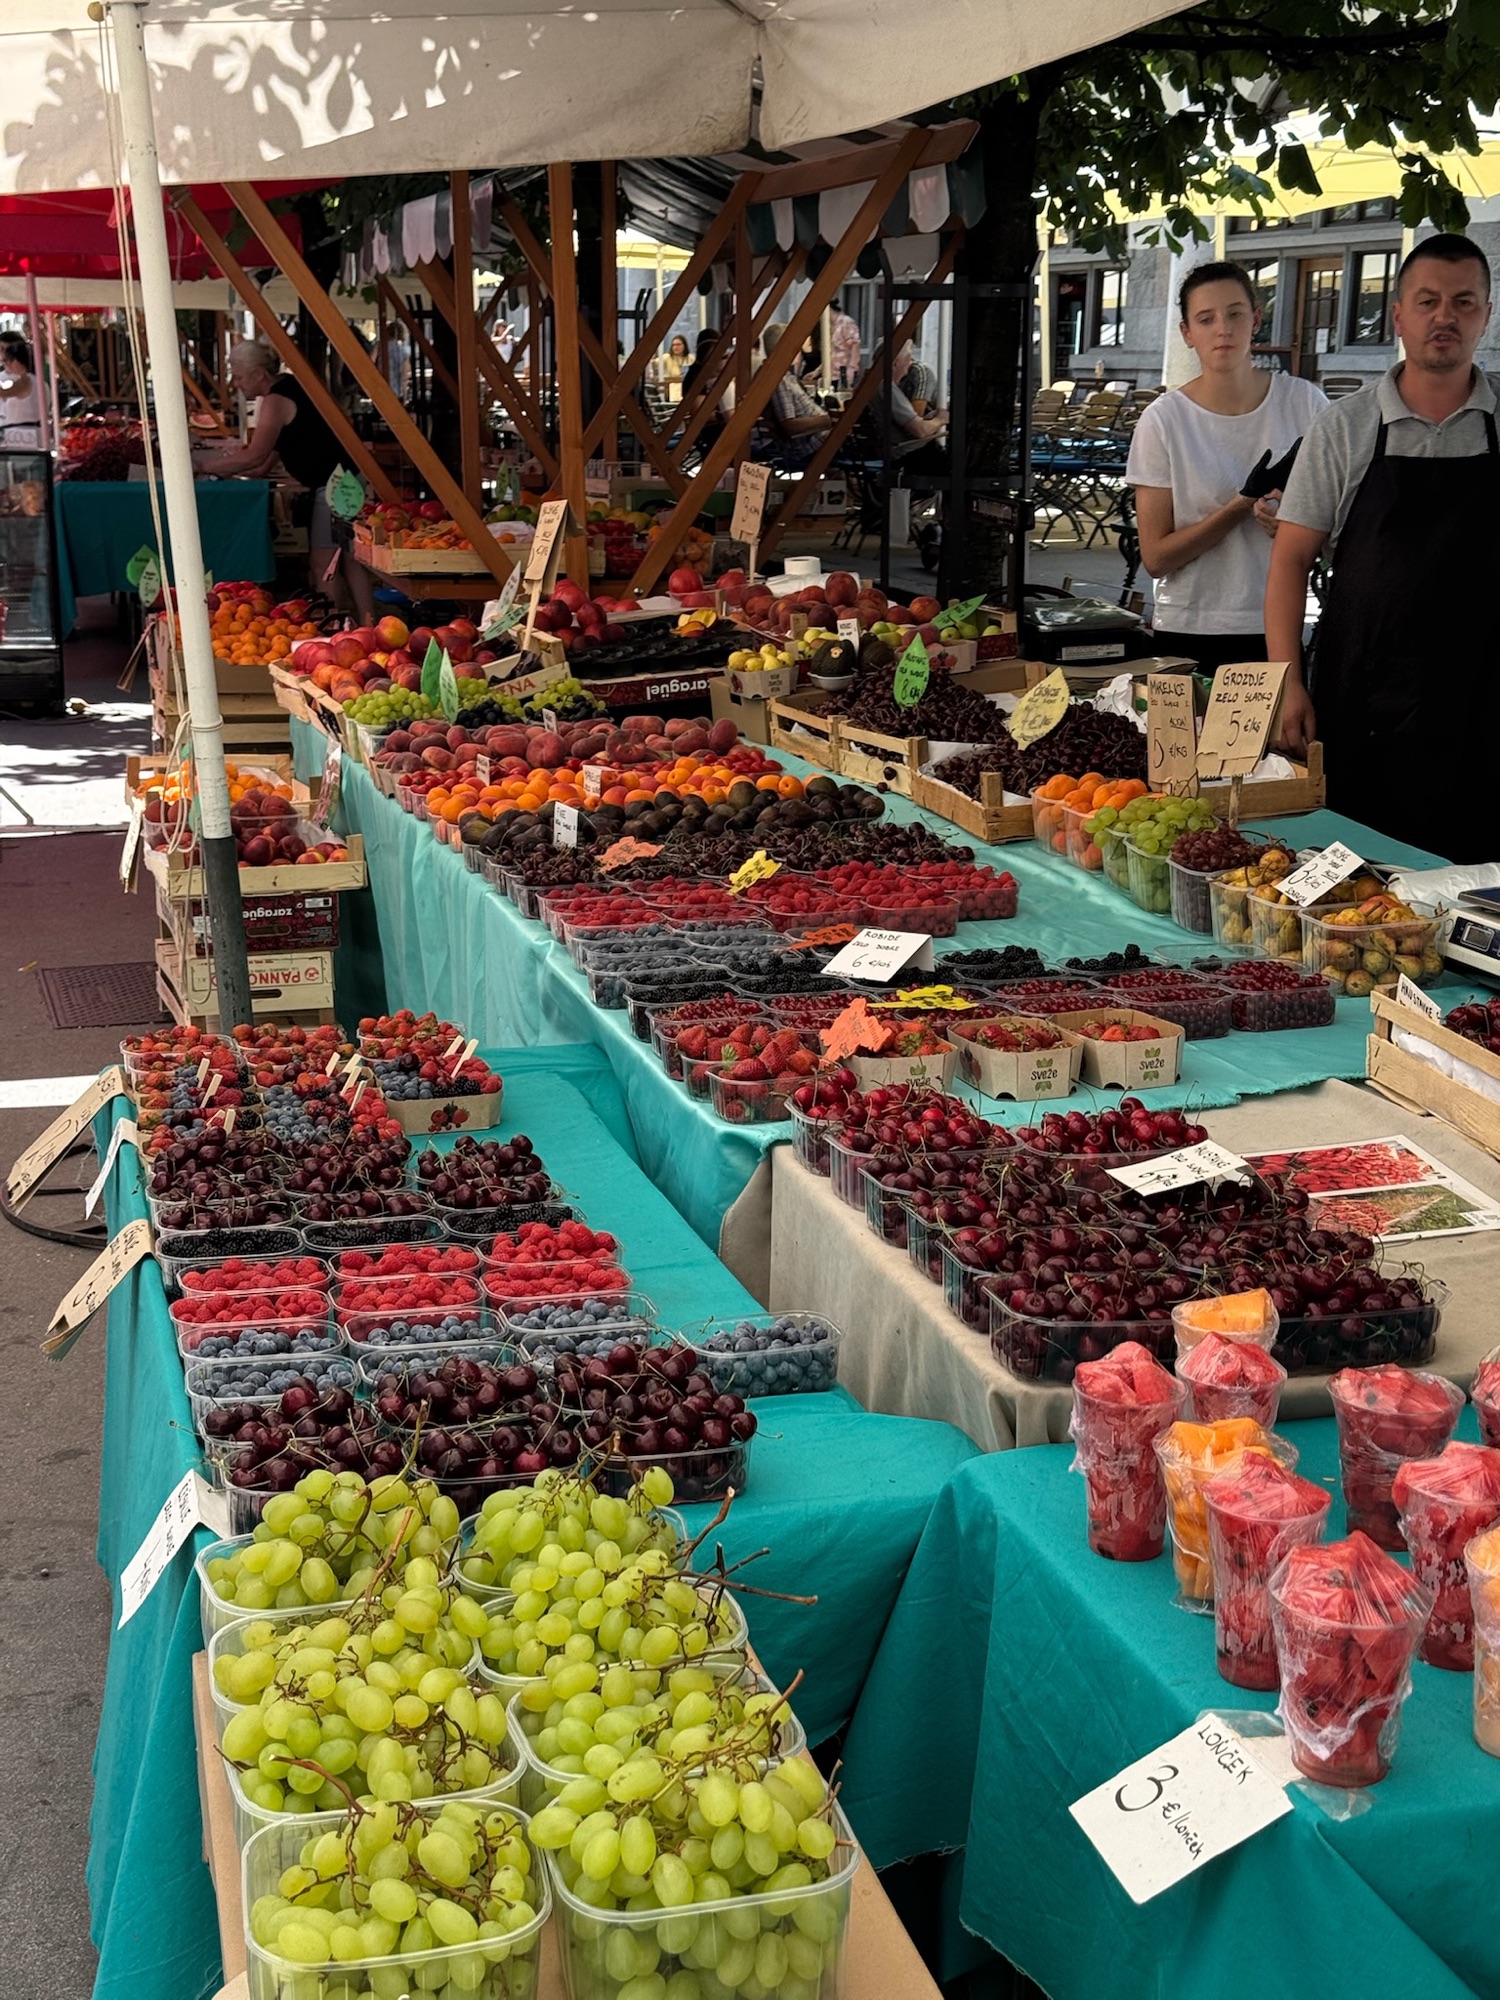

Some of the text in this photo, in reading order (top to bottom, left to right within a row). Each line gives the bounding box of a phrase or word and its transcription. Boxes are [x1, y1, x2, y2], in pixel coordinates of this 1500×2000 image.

[1222, 667, 1268, 687] GROZDJE
[1215, 692, 1239, 704] ZELO
[1244, 692, 1273, 704] SLADKO
[1226, 710, 1262, 747] 5 €/KG
[1287, 862, 1318, 885] 3
[242, 907, 292, 921] zaragüe
[864, 930, 901, 942] ROBIDE
[852, 953, 869, 968] 6
[1139, 1057, 1165, 1071] sveže
[1030, 1067, 1058, 1082] sveže
[72, 1265, 106, 1308] 3
[1197, 1723, 1254, 1785] LONČEK
[1114, 1764, 1206, 1861] 3 €/lonček
